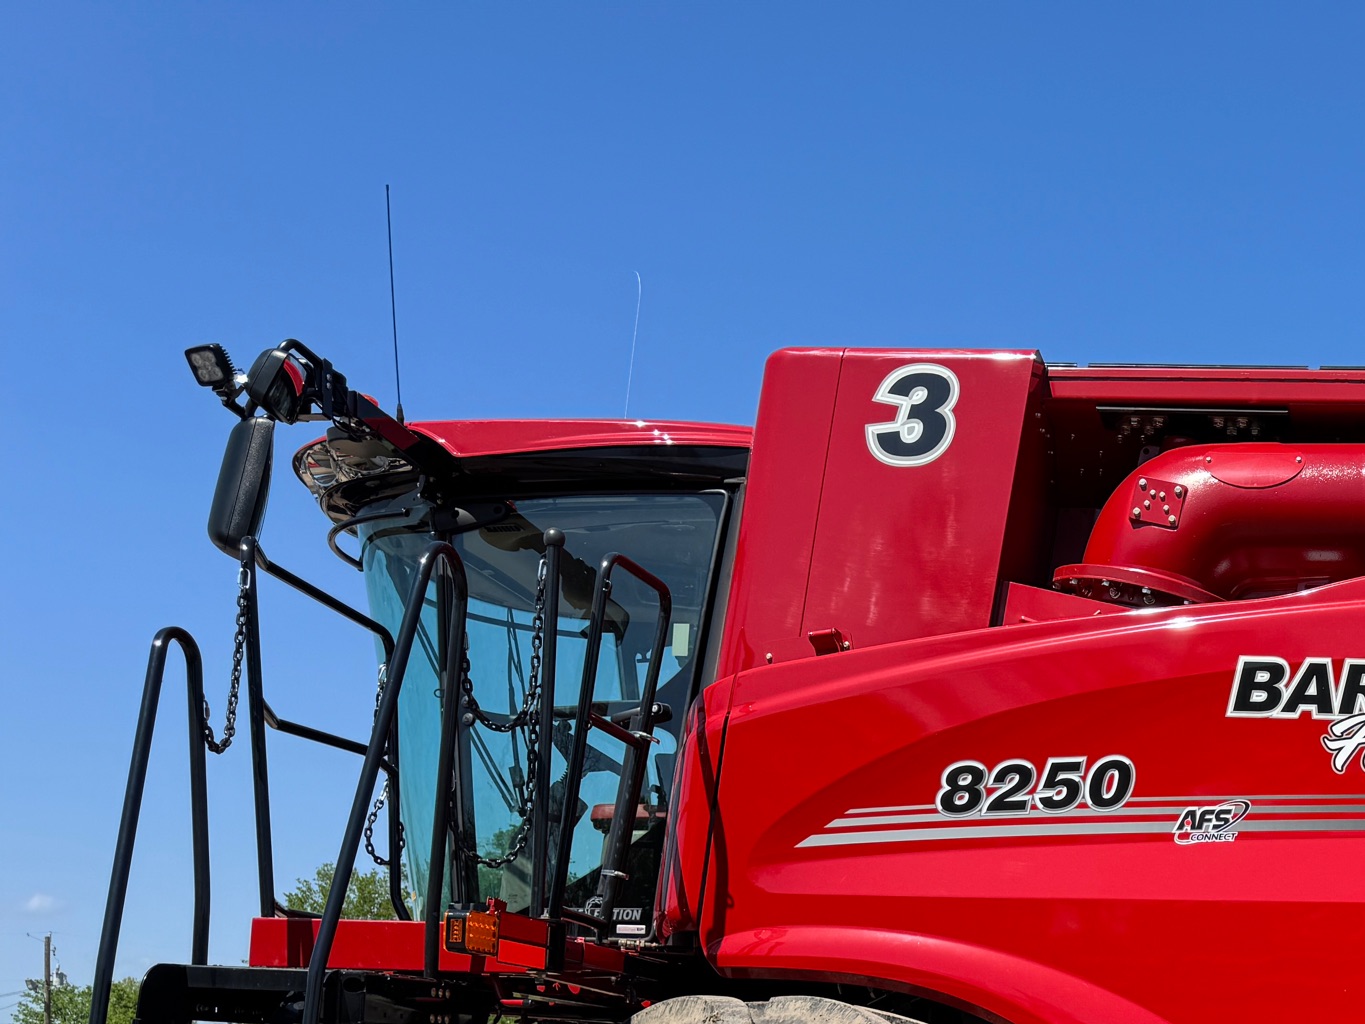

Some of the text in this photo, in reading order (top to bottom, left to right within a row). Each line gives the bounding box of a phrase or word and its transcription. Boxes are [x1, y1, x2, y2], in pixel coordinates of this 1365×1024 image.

[865, 363, 960, 467] 3
[935, 755, 1136, 818] 8250
[1174, 806, 1235, 832] AFS
[1190, 832, 1237, 842] CONNECT
